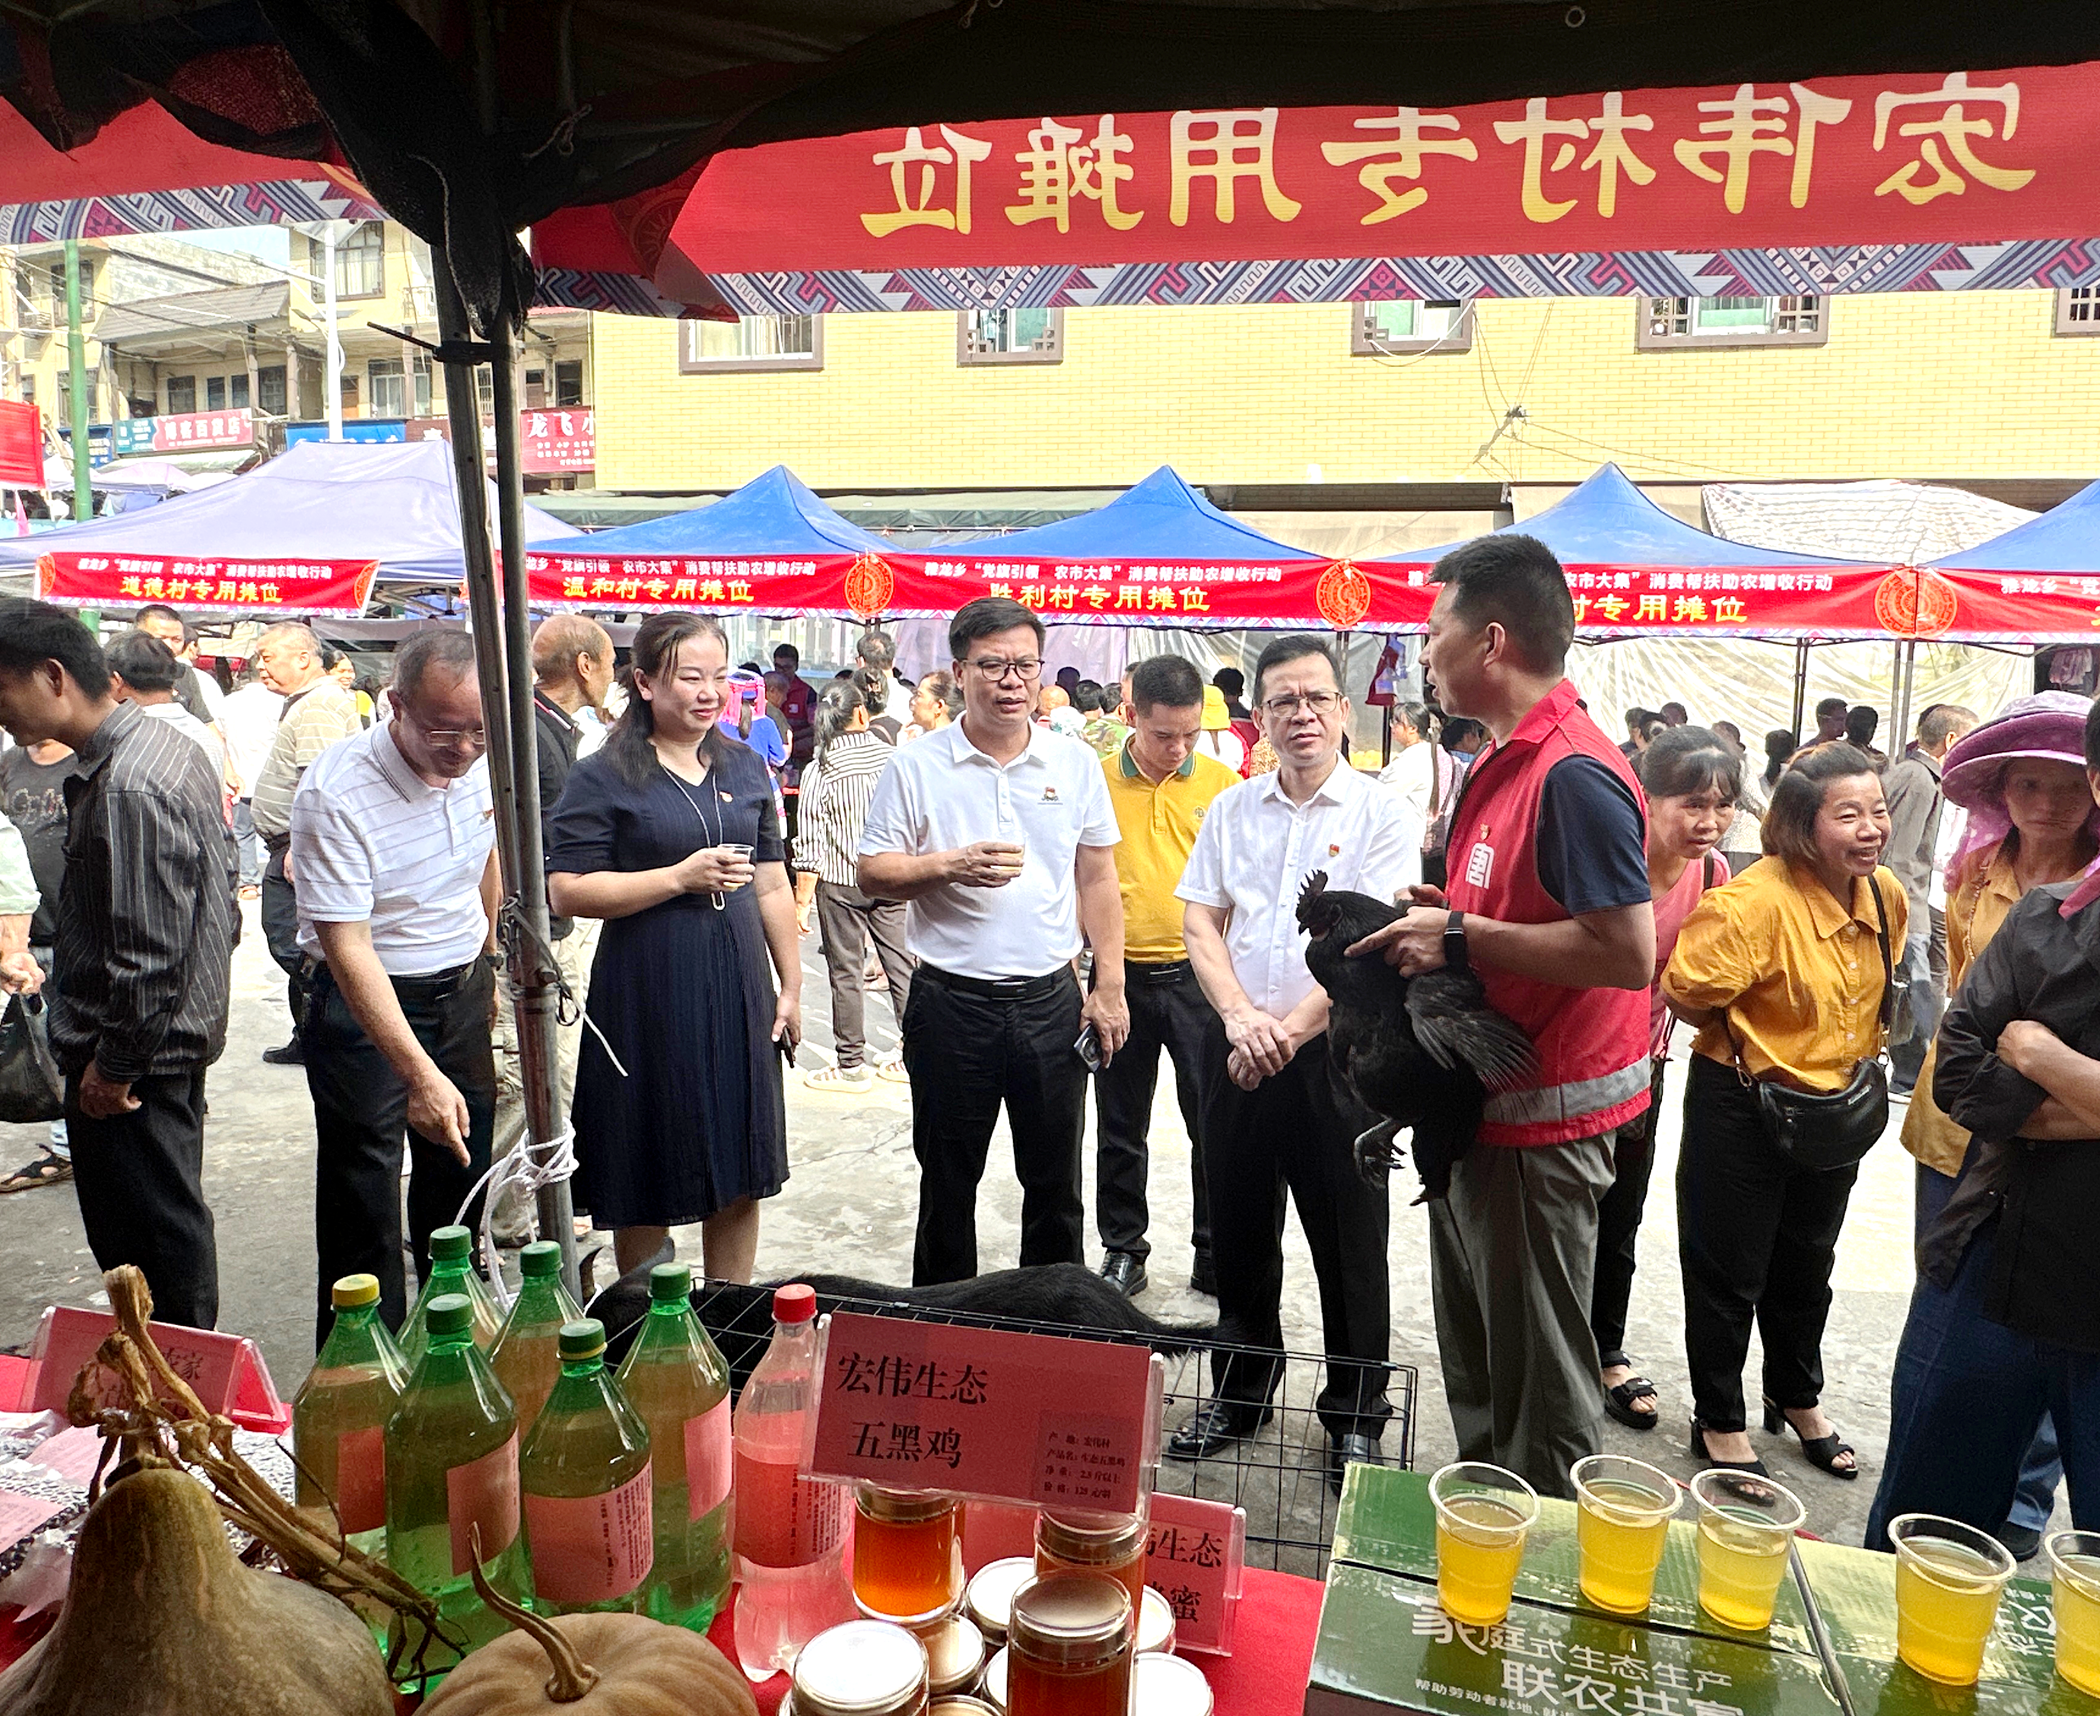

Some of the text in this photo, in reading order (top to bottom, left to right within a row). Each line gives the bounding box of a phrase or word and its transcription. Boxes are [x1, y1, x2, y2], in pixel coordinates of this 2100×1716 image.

[1128, 566, 1282, 583] 消费帮扶助农增收行动
[1649, 571, 1832, 591] 消费帮扶助农增收行动
[120, 576, 283, 603] 道德村专用摊位
[563, 576, 755, 603] 温和村专用摊位
[989, 583, 1211, 612] 胜利村专用摊位
[836, 1351, 989, 1406] 宏伟生态
[846, 1419, 964, 1470] 五黑鸡
[1411, 1595, 1733, 1693] 家庭式生态生产
